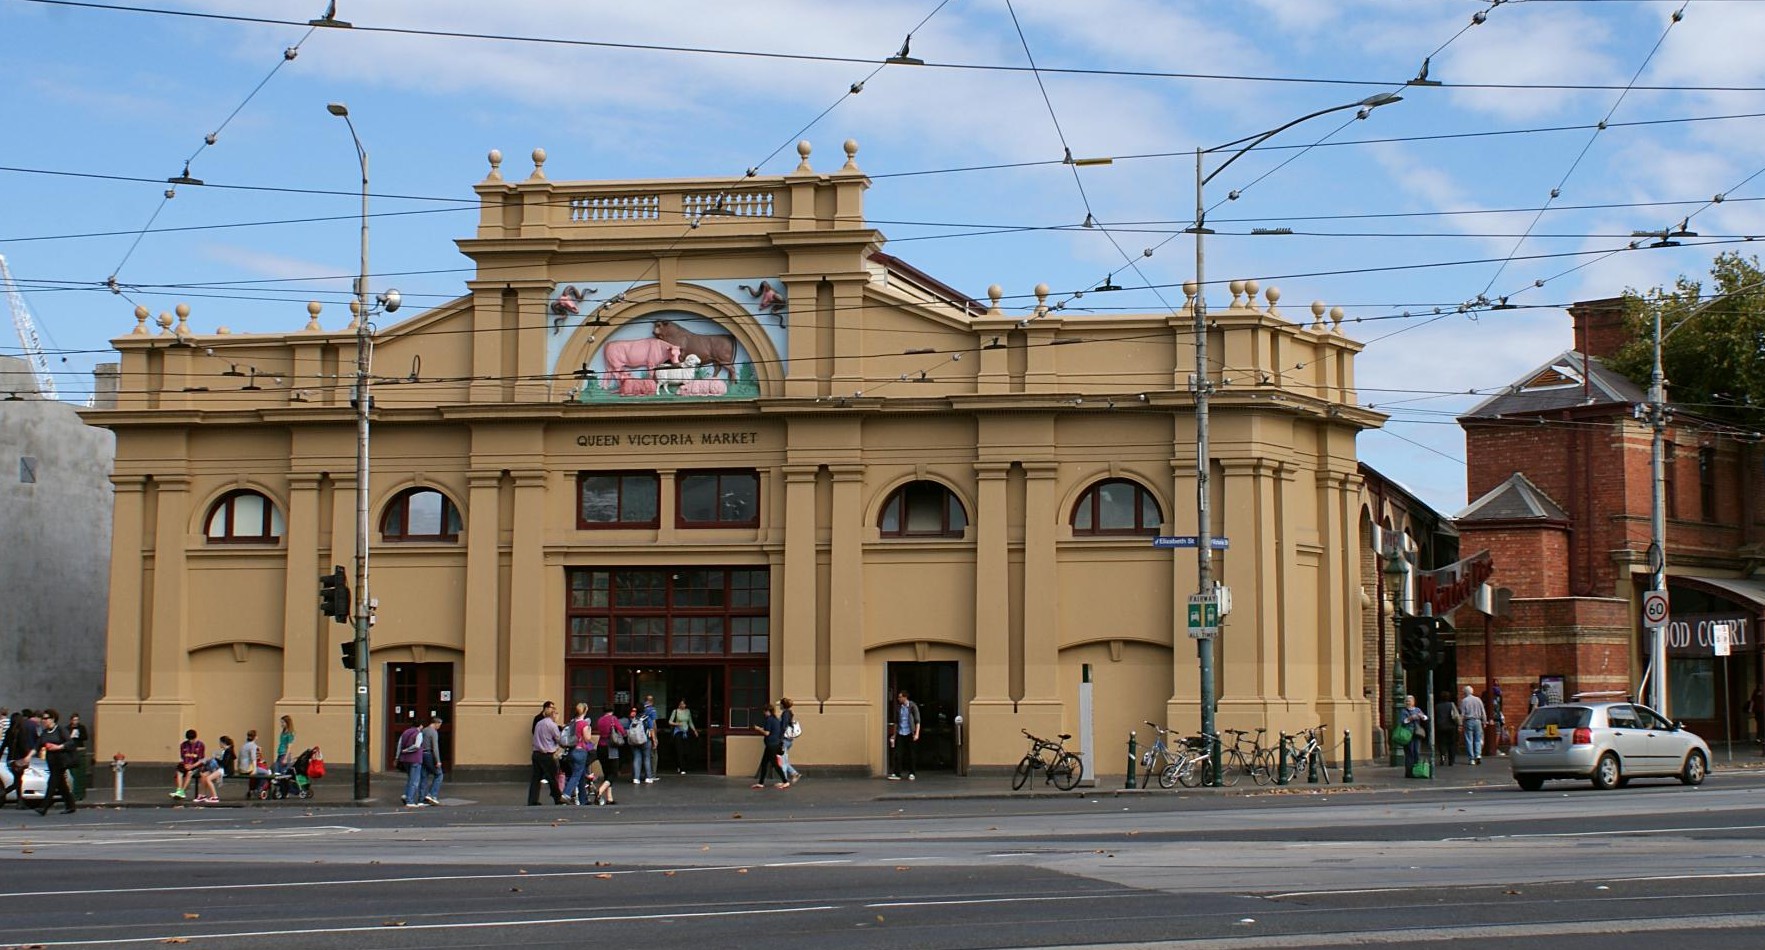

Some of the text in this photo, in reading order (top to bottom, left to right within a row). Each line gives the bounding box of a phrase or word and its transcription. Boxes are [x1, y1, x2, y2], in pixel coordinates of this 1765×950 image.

[577, 432, 758, 447] QUEEN VICTORIA MARKET
[1649, 602, 1664, 615] 60
[1698, 618, 1748, 648] CORT
[1549, 725, 1556, 736] L
